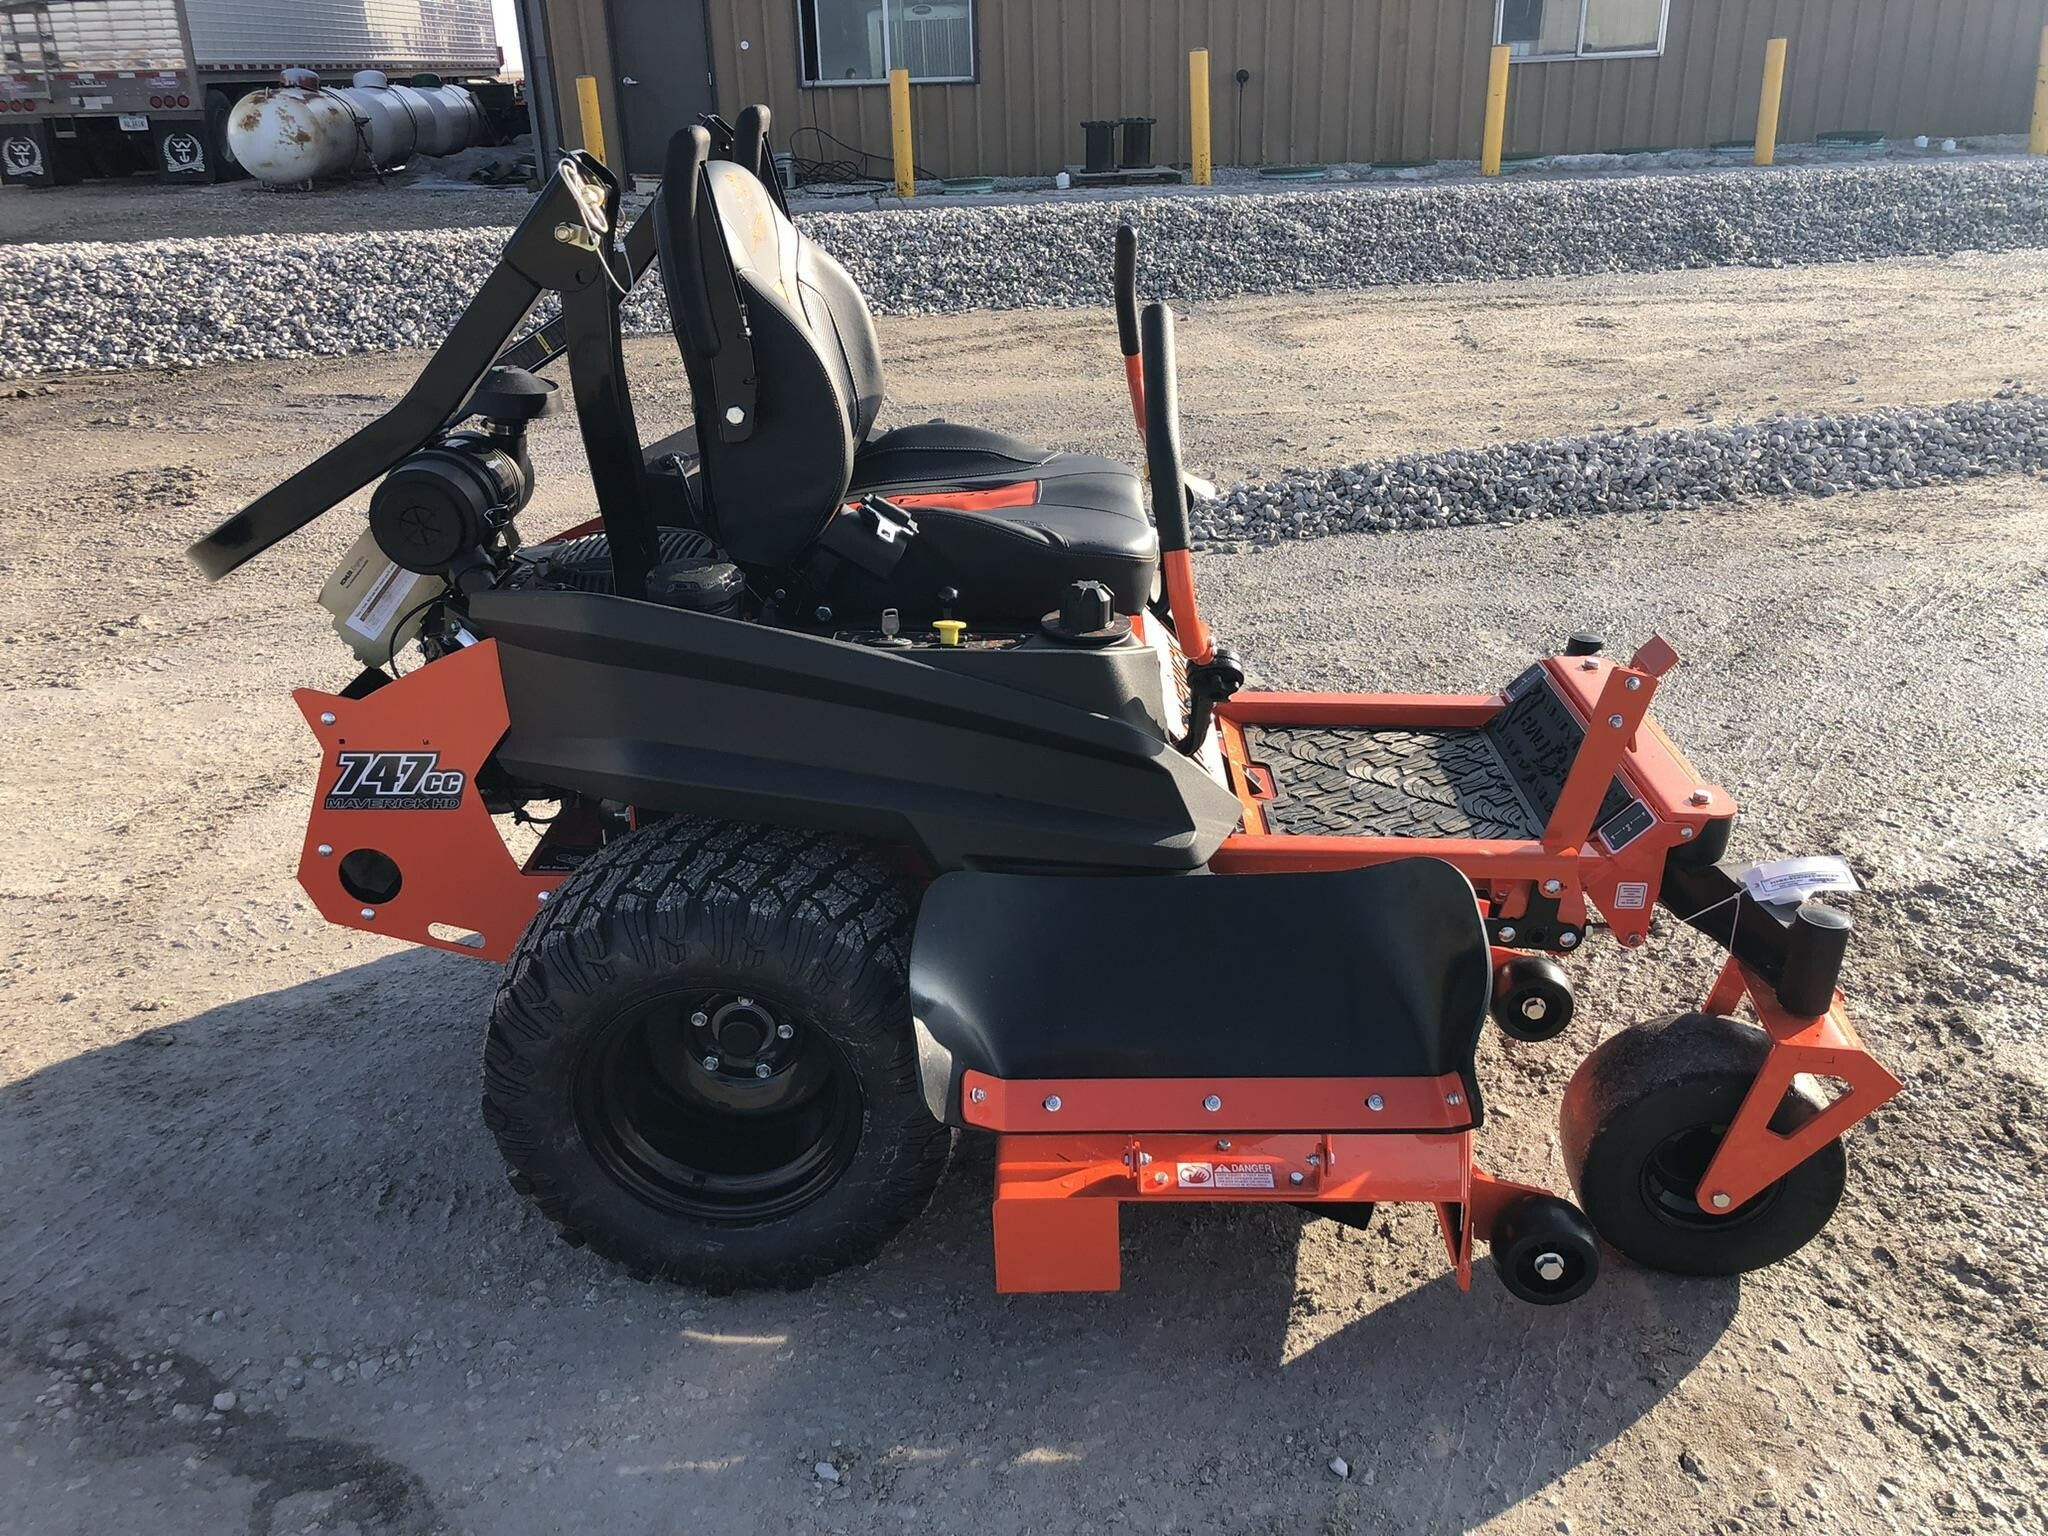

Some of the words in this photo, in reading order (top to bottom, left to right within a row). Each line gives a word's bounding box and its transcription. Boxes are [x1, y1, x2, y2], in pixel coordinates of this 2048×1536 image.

[325, 798, 430, 809] MAVERICK
[431, 798, 461, 809] HD
[1231, 1163, 1273, 1173] DANGER
